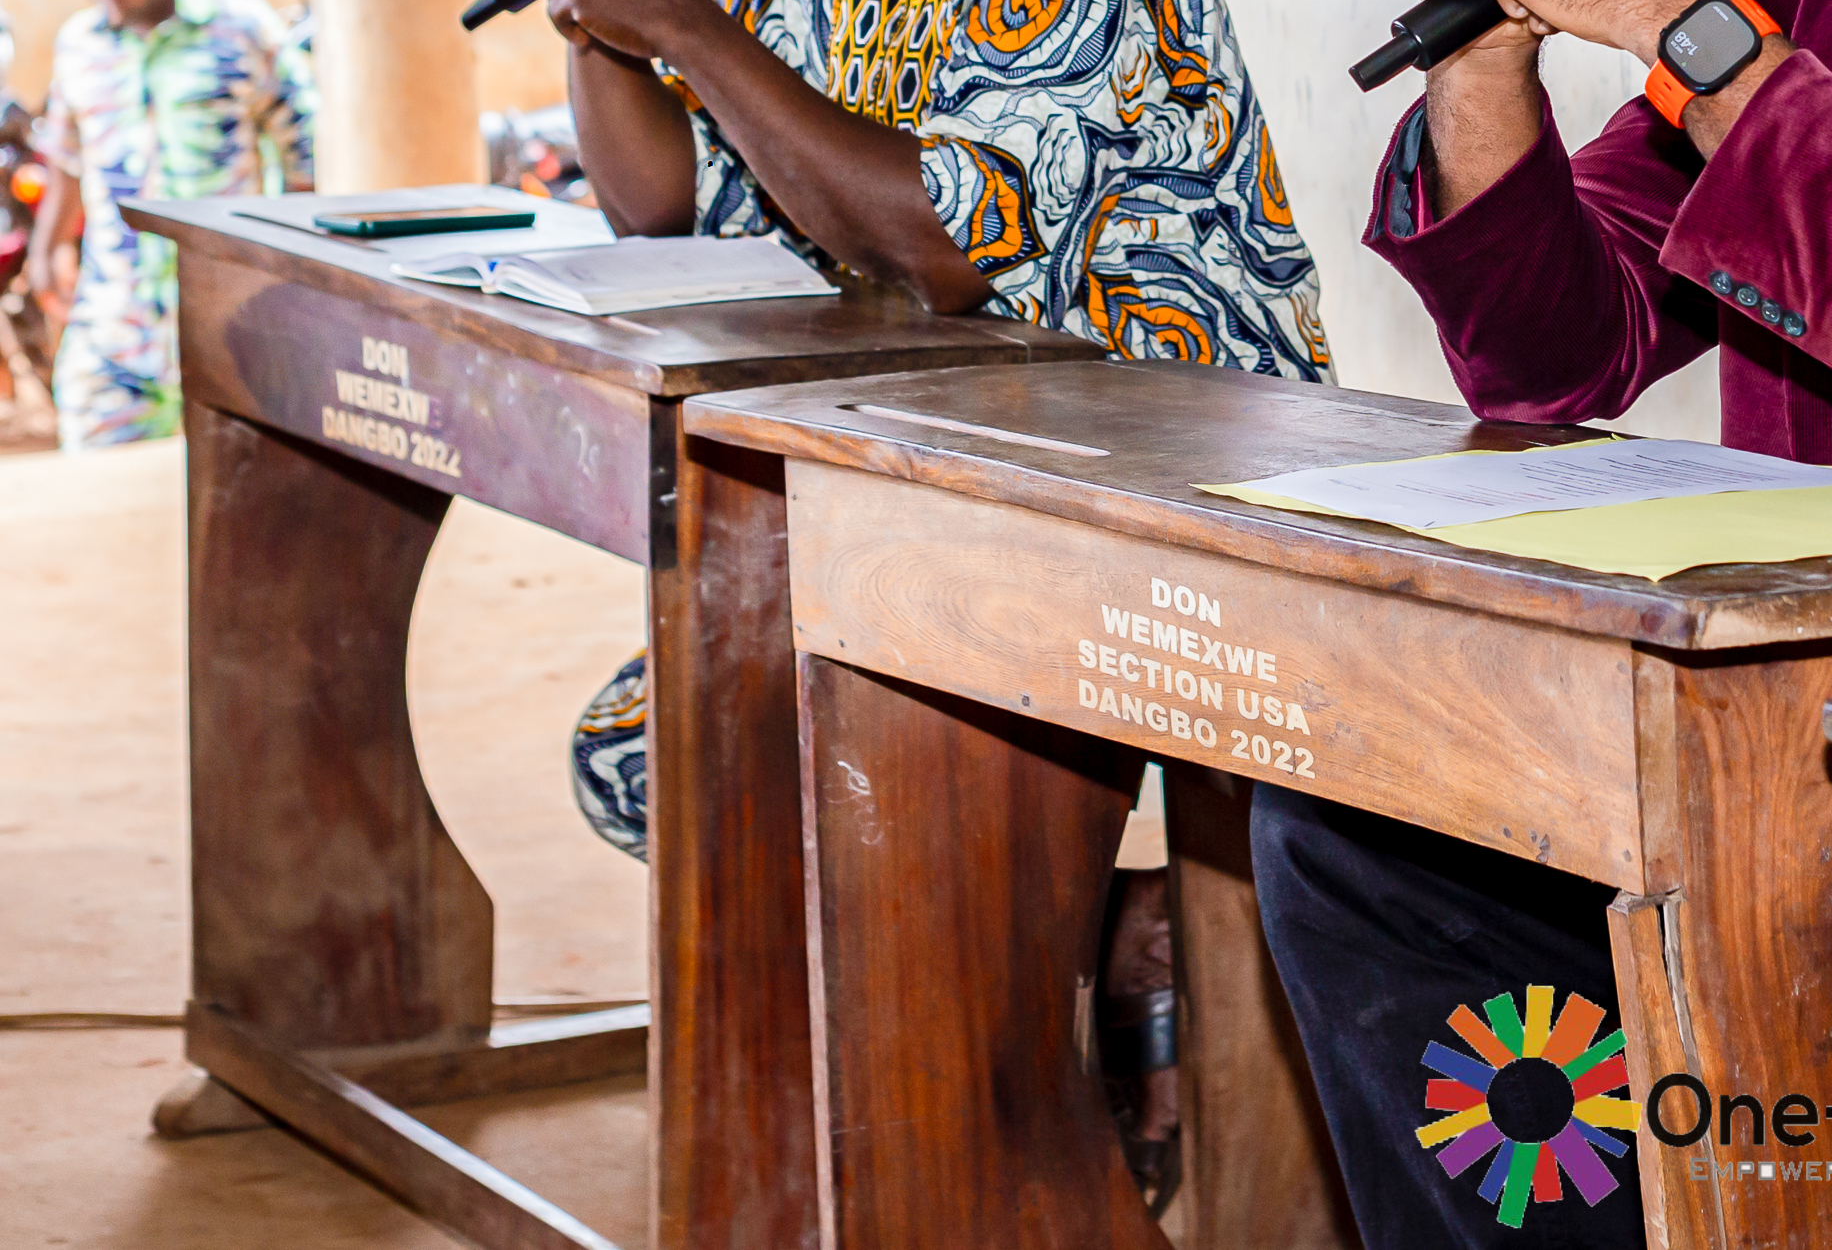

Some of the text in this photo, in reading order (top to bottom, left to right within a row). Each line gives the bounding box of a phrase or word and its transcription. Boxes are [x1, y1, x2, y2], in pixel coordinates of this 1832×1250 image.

[1674, 31, 1699, 56] 1:48
[362, 335, 410, 379] DON
[322, 405, 409, 461] DANGBO
[1151, 577, 1221, 627] DON
[1101, 604, 1277, 683] WEMEXWE
[1078, 639, 1311, 736] SECTION USA
[1078, 678, 1315, 779] DANGBO 2022
